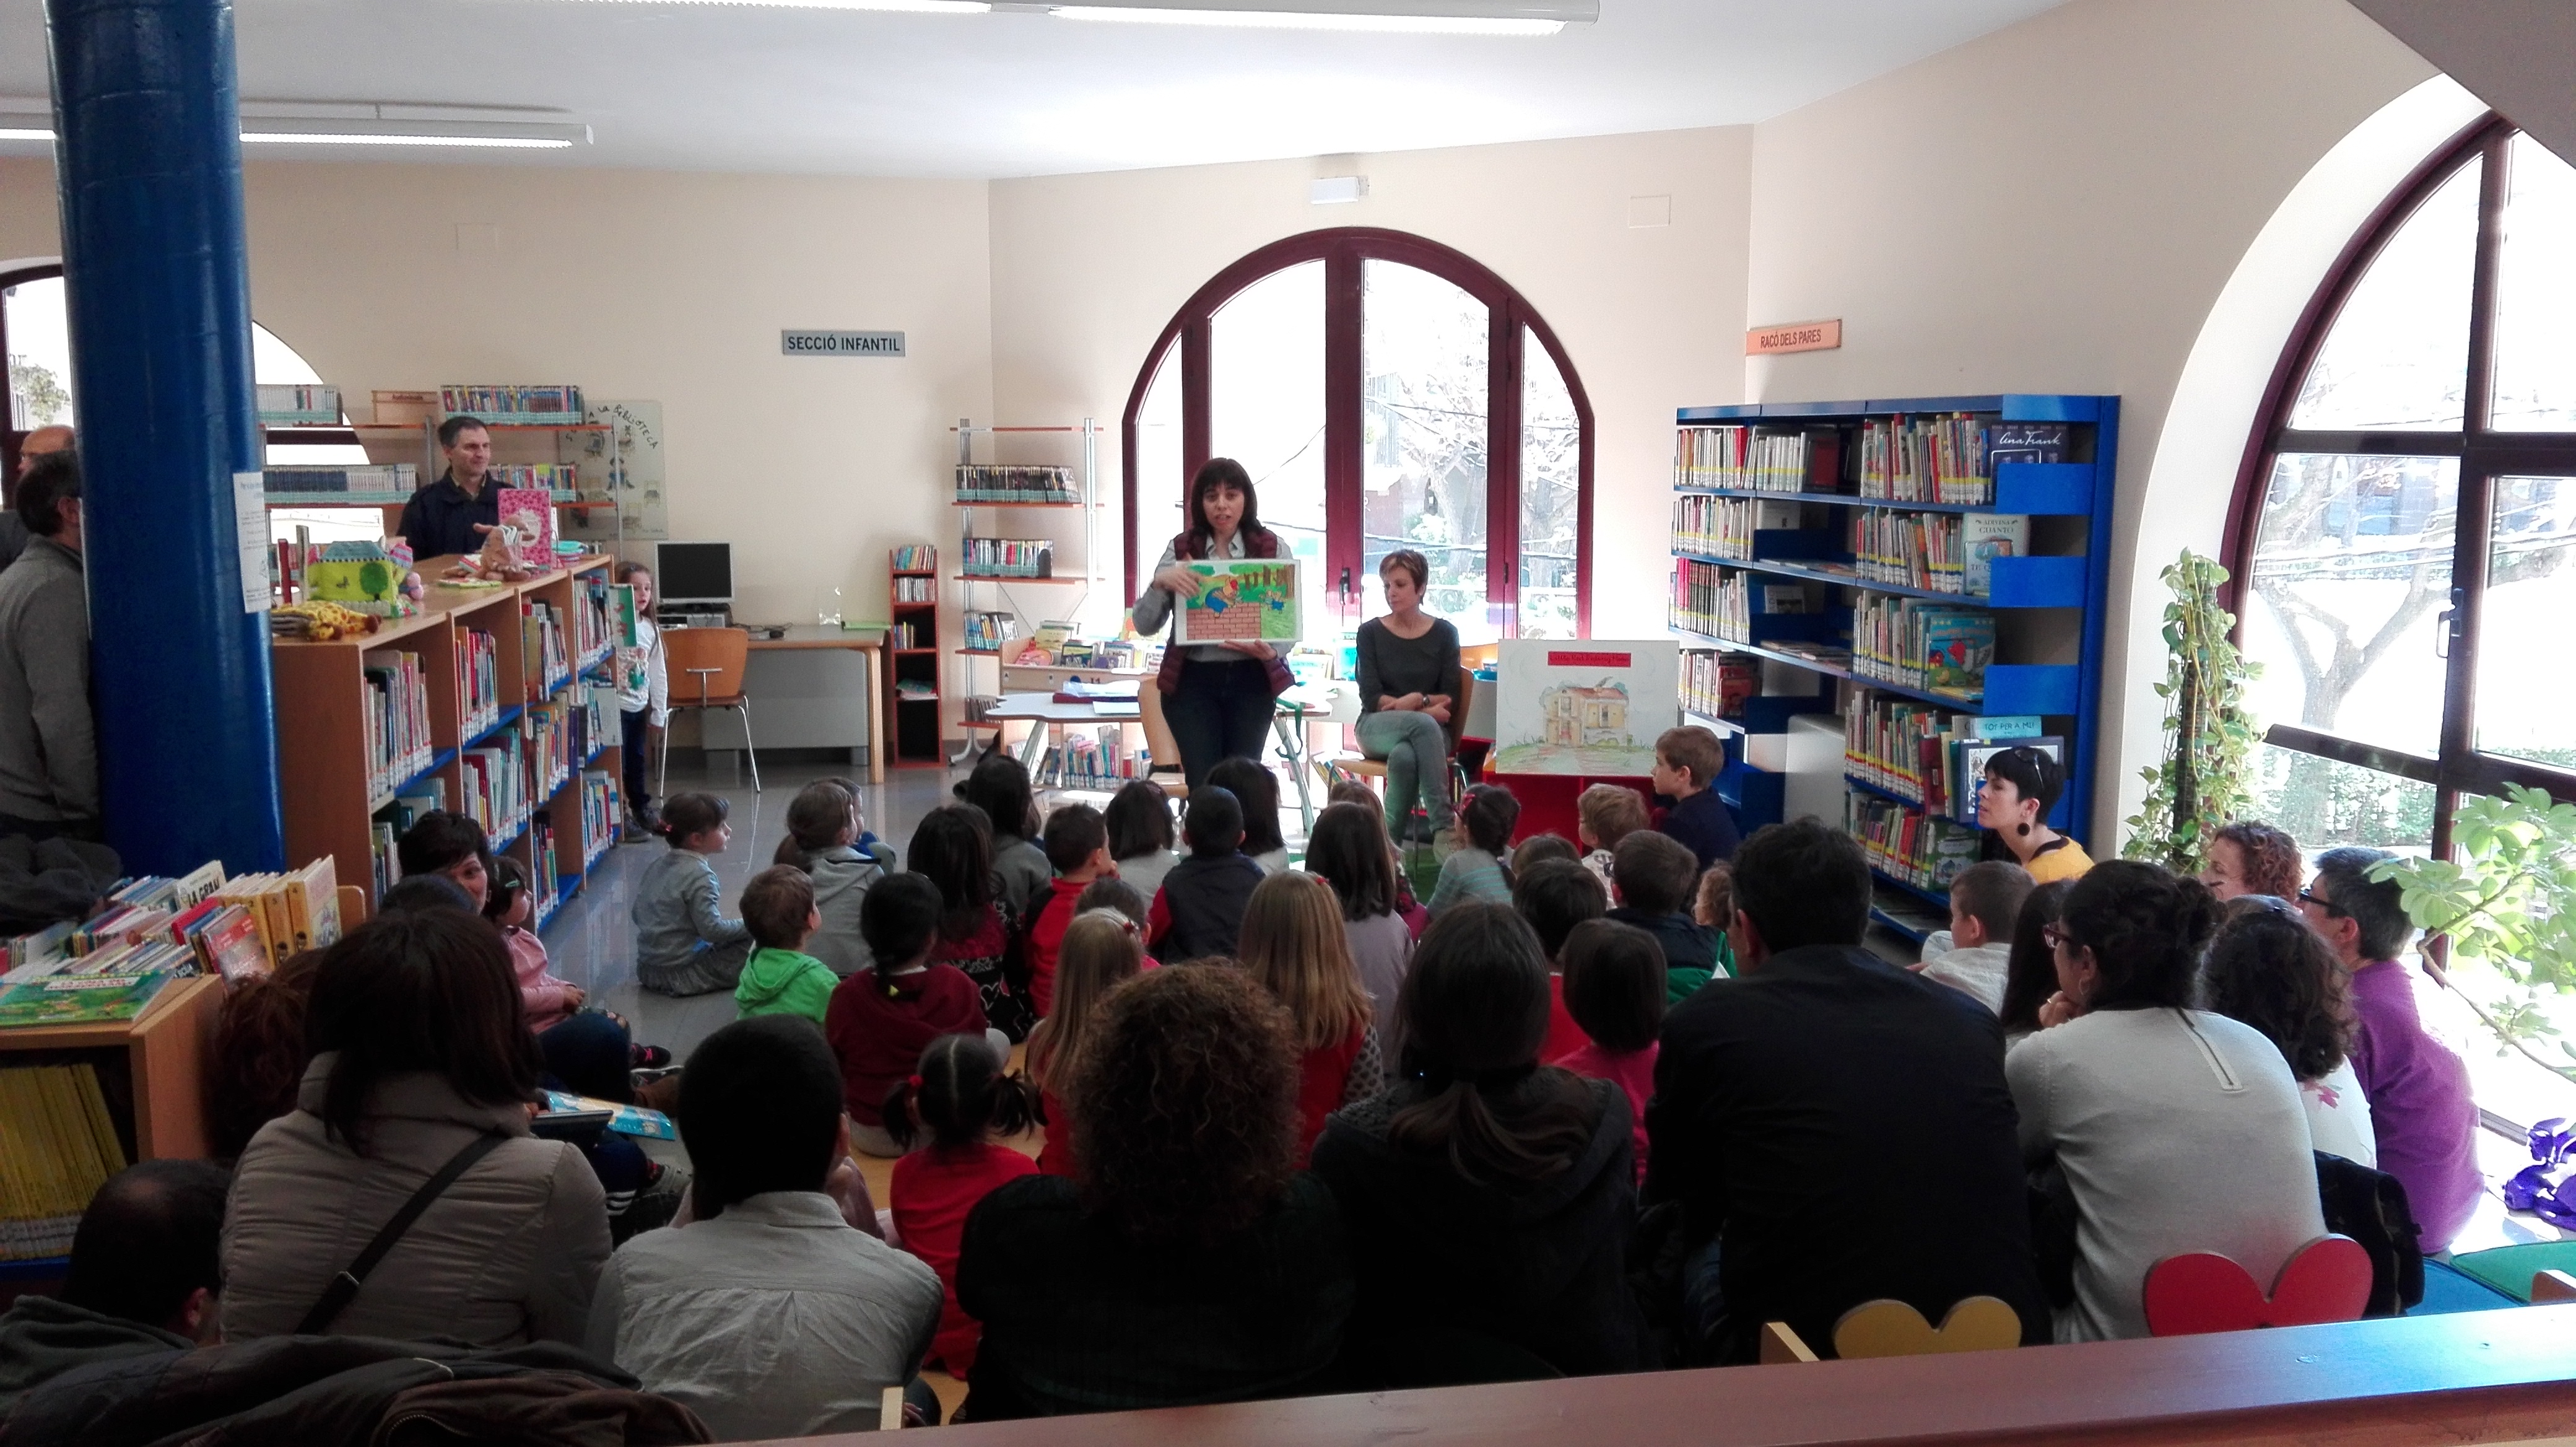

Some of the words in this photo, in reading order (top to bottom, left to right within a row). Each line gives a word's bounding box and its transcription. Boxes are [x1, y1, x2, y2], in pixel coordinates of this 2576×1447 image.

[788, 334, 837, 351] SECCIÓ
[841, 337, 900, 351] INFANTIL
[1760, 331, 1778, 349] RACÓ
[1780, 332, 1797, 346] DELS
[1798, 329, 1822, 344] PARES
[2025, 431, 2062, 446] Frank
[187, 889, 199, 907] LA
[198, 876, 220, 901] GRAN
